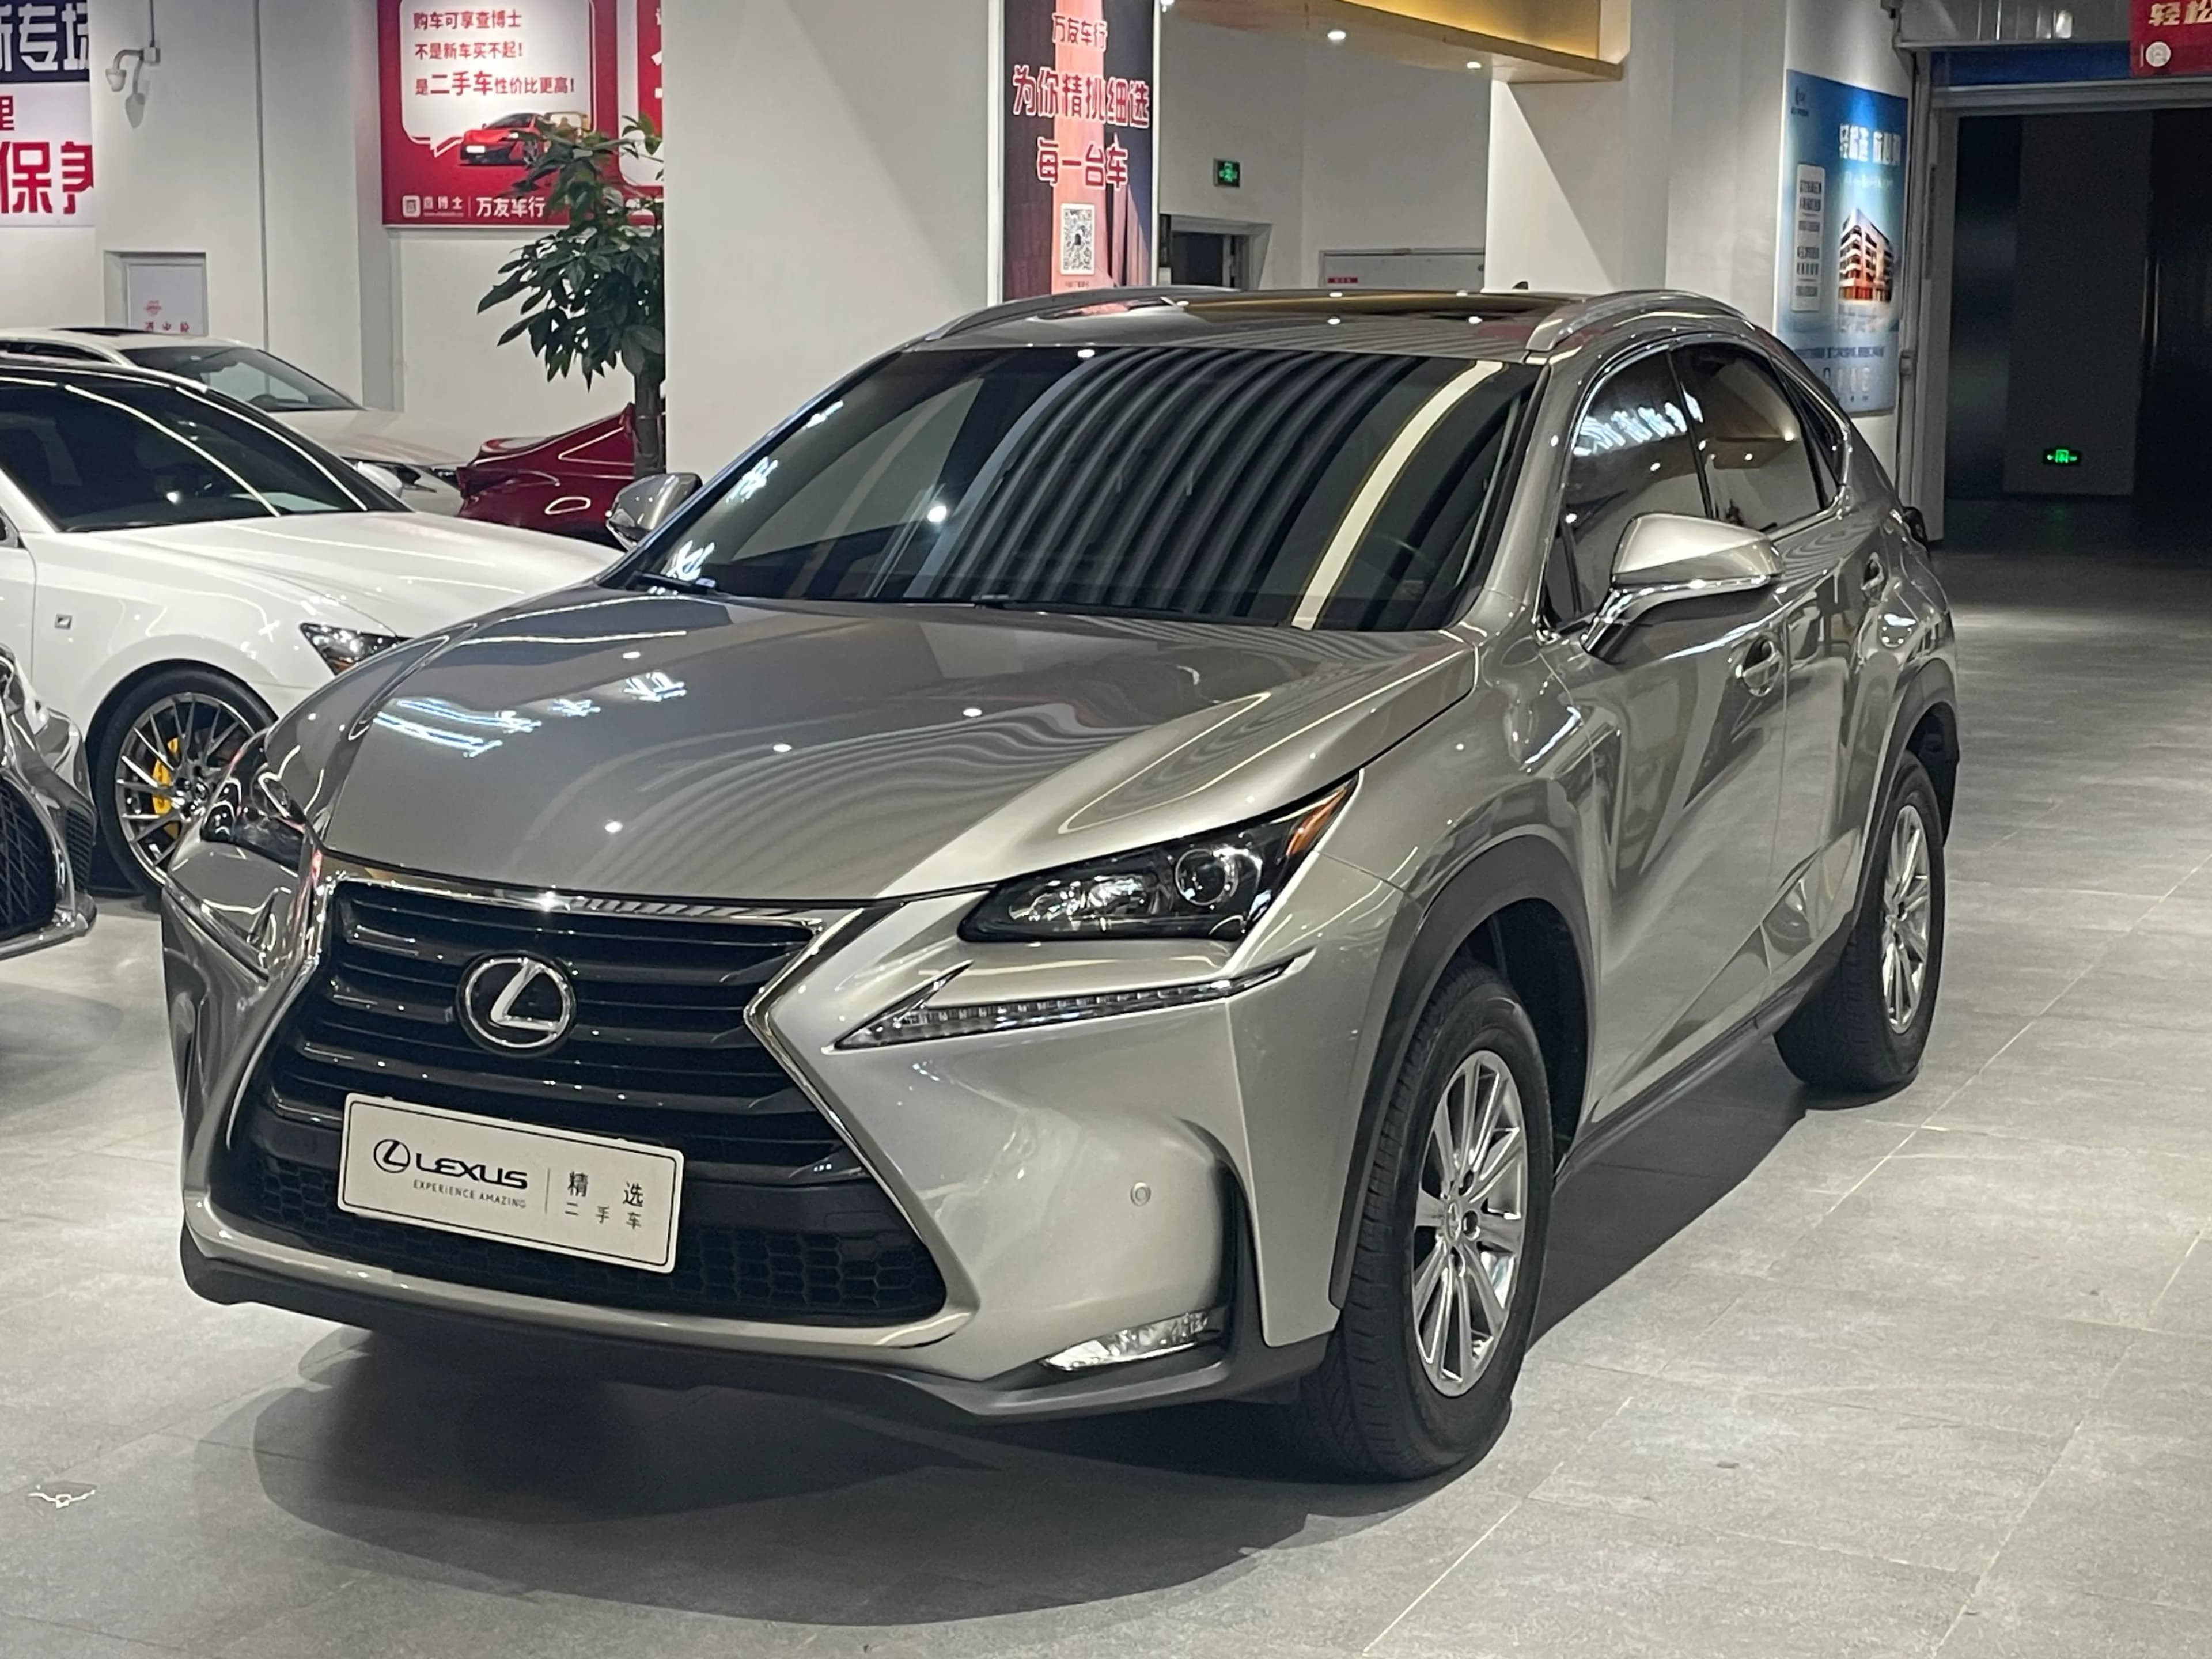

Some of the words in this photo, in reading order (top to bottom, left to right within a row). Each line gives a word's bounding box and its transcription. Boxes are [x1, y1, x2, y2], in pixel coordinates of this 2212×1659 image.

[413, 10, 522, 30] 购车可享查博士
[1052, 13, 1108, 51] 万友车行
[0, 3, 88, 72] 专场
[415, 41, 523, 59] 不是新车买不起！
[415, 70, 575, 96] 是二手车性价比更高！
[1013, 65, 1150, 128] 为你精挑细选
[1037, 136, 1128, 191] 每一台车
[476, 196, 546, 217] 万友车行
[415, 1153, 528, 1190] LEXUS
[413, 1179, 475, 1200] EXPERIENCE
[479, 1192, 527, 1209] AMAZING
[565, 1202, 641, 1230] 二手车
